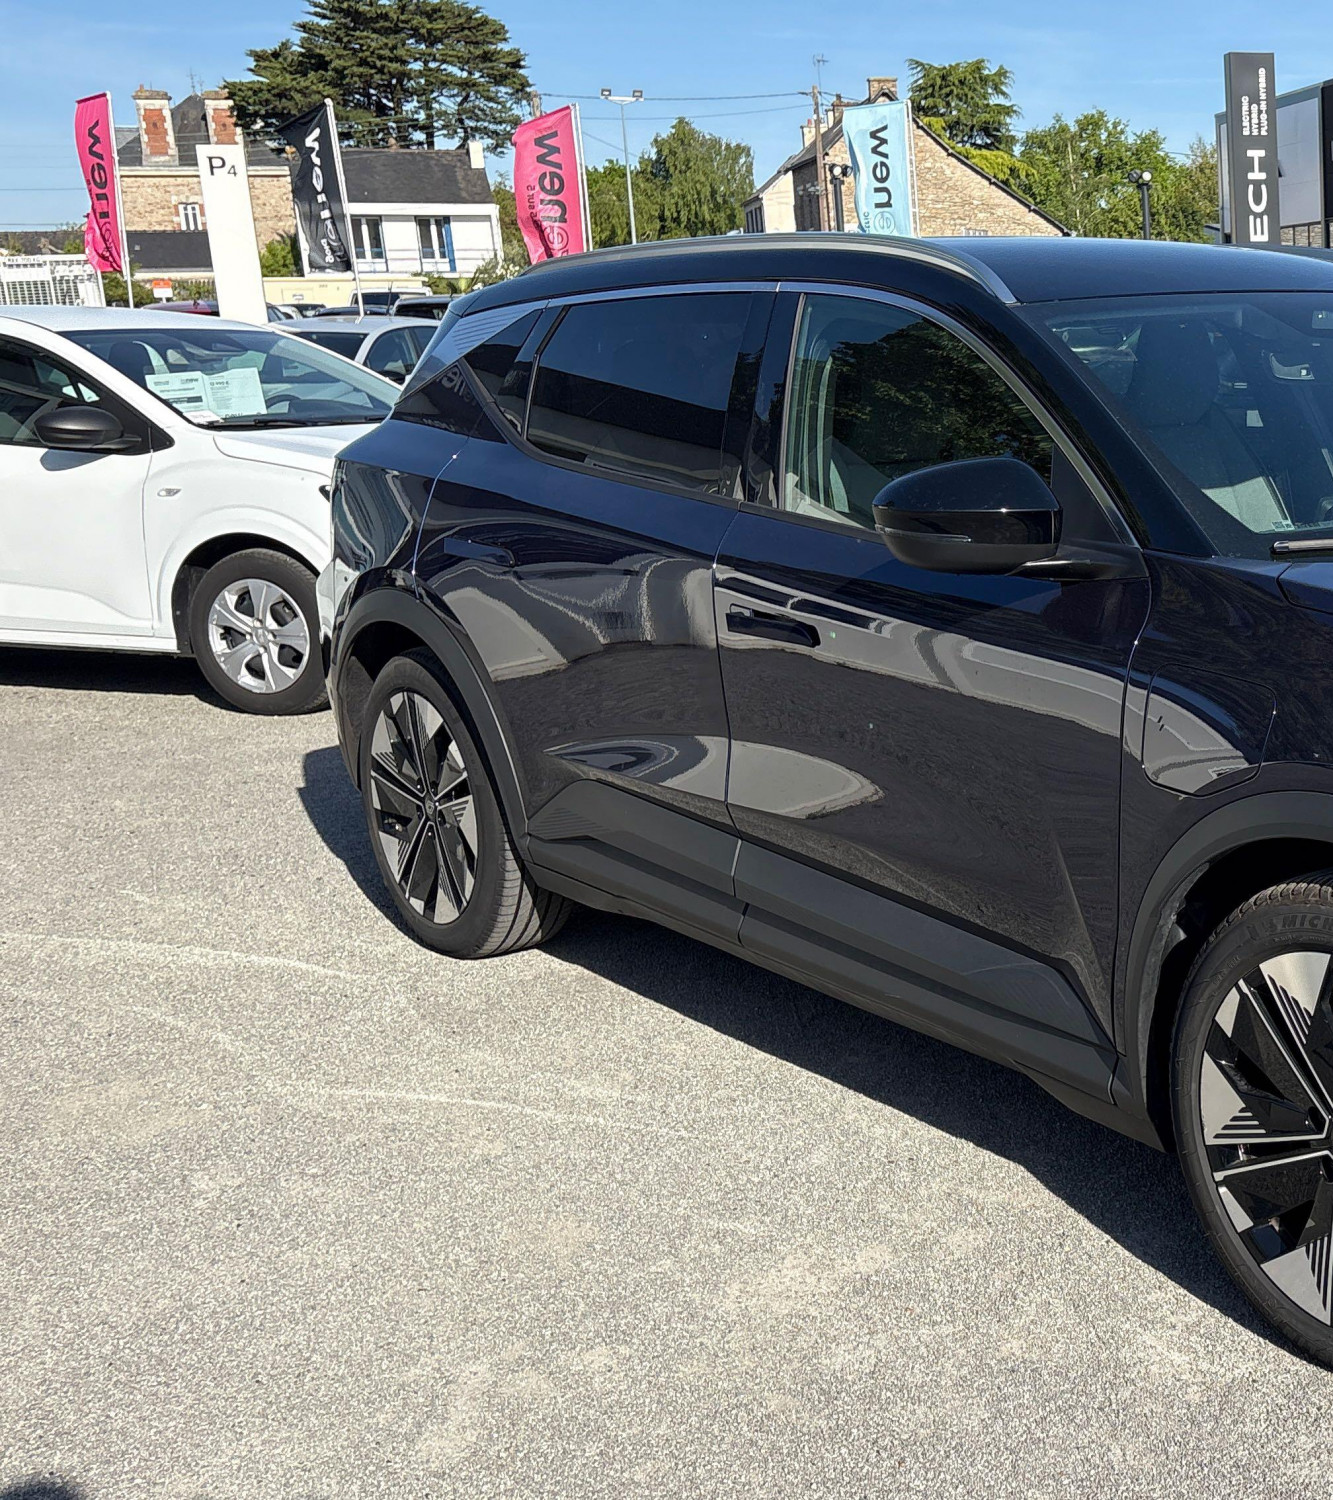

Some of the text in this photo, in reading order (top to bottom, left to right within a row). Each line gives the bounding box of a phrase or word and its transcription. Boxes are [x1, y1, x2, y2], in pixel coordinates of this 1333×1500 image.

[1241, 95, 1250, 136] ELECTRIC
[1250, 103, 1259, 136] HYBRID
[206, 155, 238, 178] P4
[1246, 149, 1269, 242] ECH
